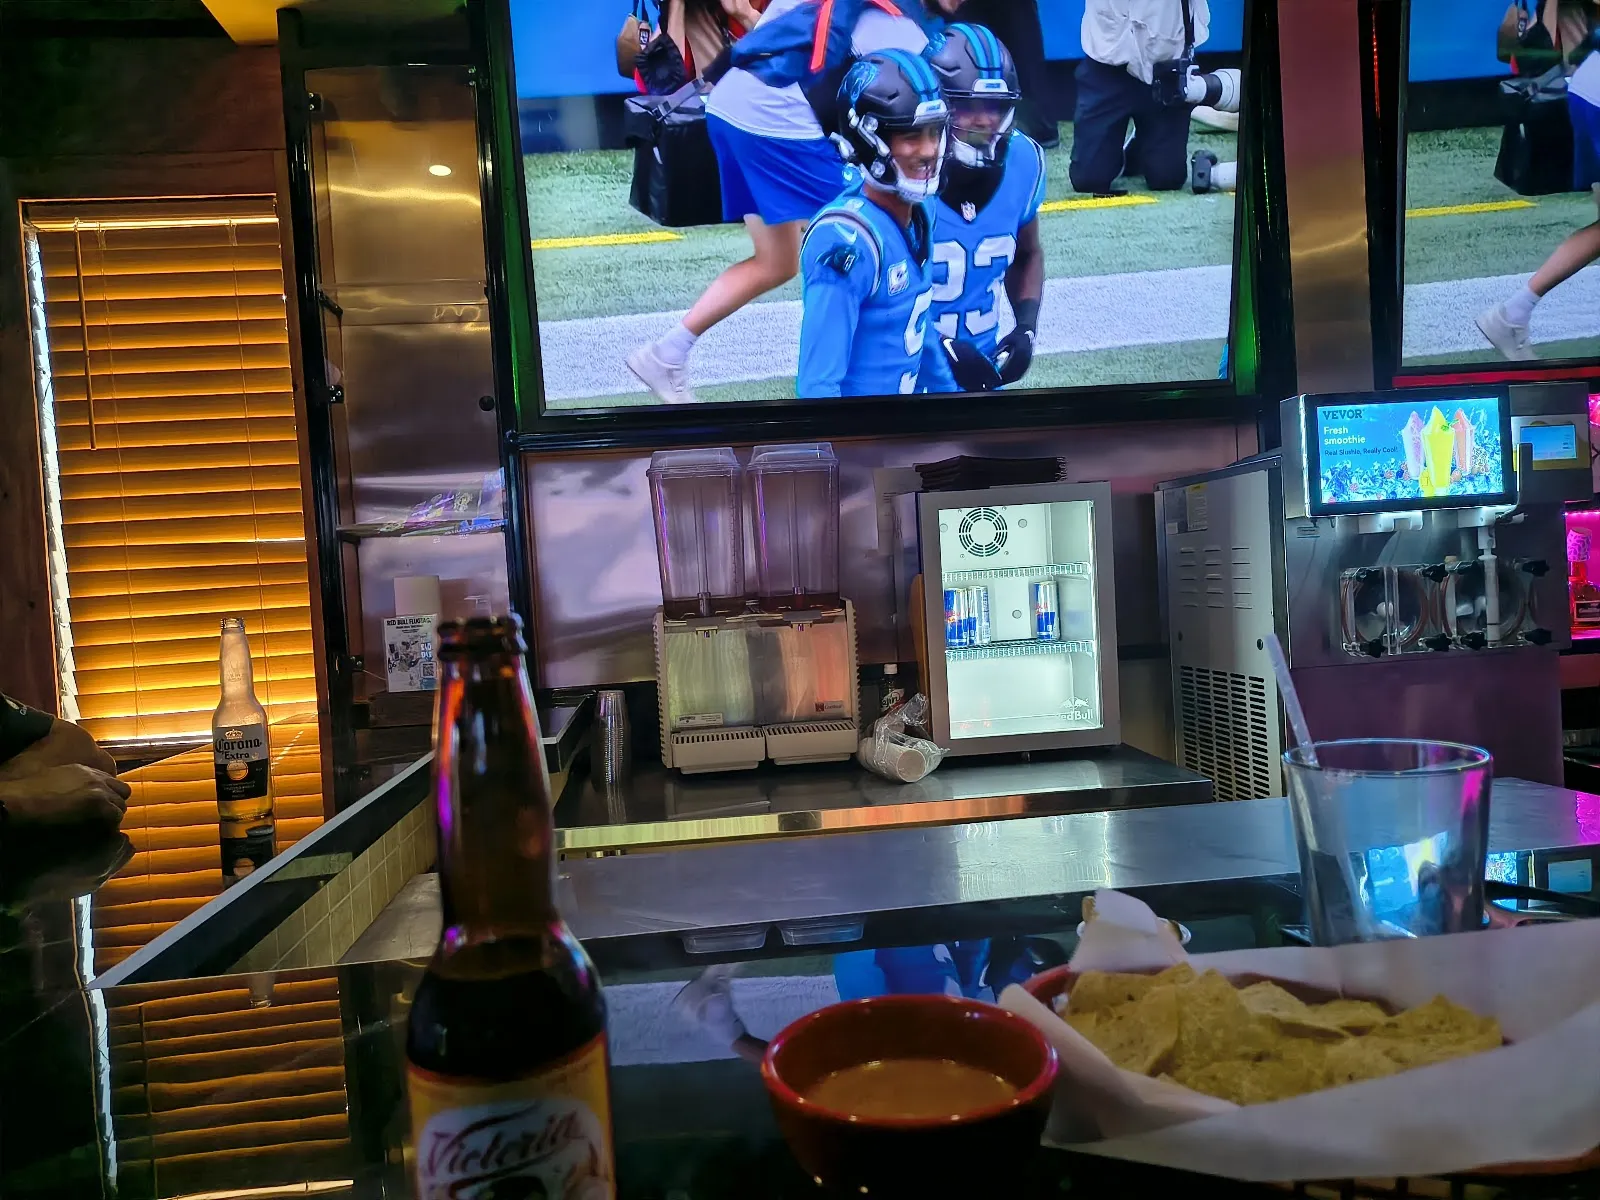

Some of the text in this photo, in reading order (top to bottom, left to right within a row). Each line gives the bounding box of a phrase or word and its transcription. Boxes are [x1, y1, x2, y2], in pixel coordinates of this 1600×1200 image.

[931, 234, 1017, 339] 23
[1322, 409, 1363, 420] VEVOR
[1324, 426, 1348, 435] Fresh
[1324, 435, 1366, 445] smoothie
[1363, 447, 1381, 455] Really
[1074, 708, 1094, 721] Bull
[215, 738, 262, 755] Corona
[224, 750, 250, 760] Extra
